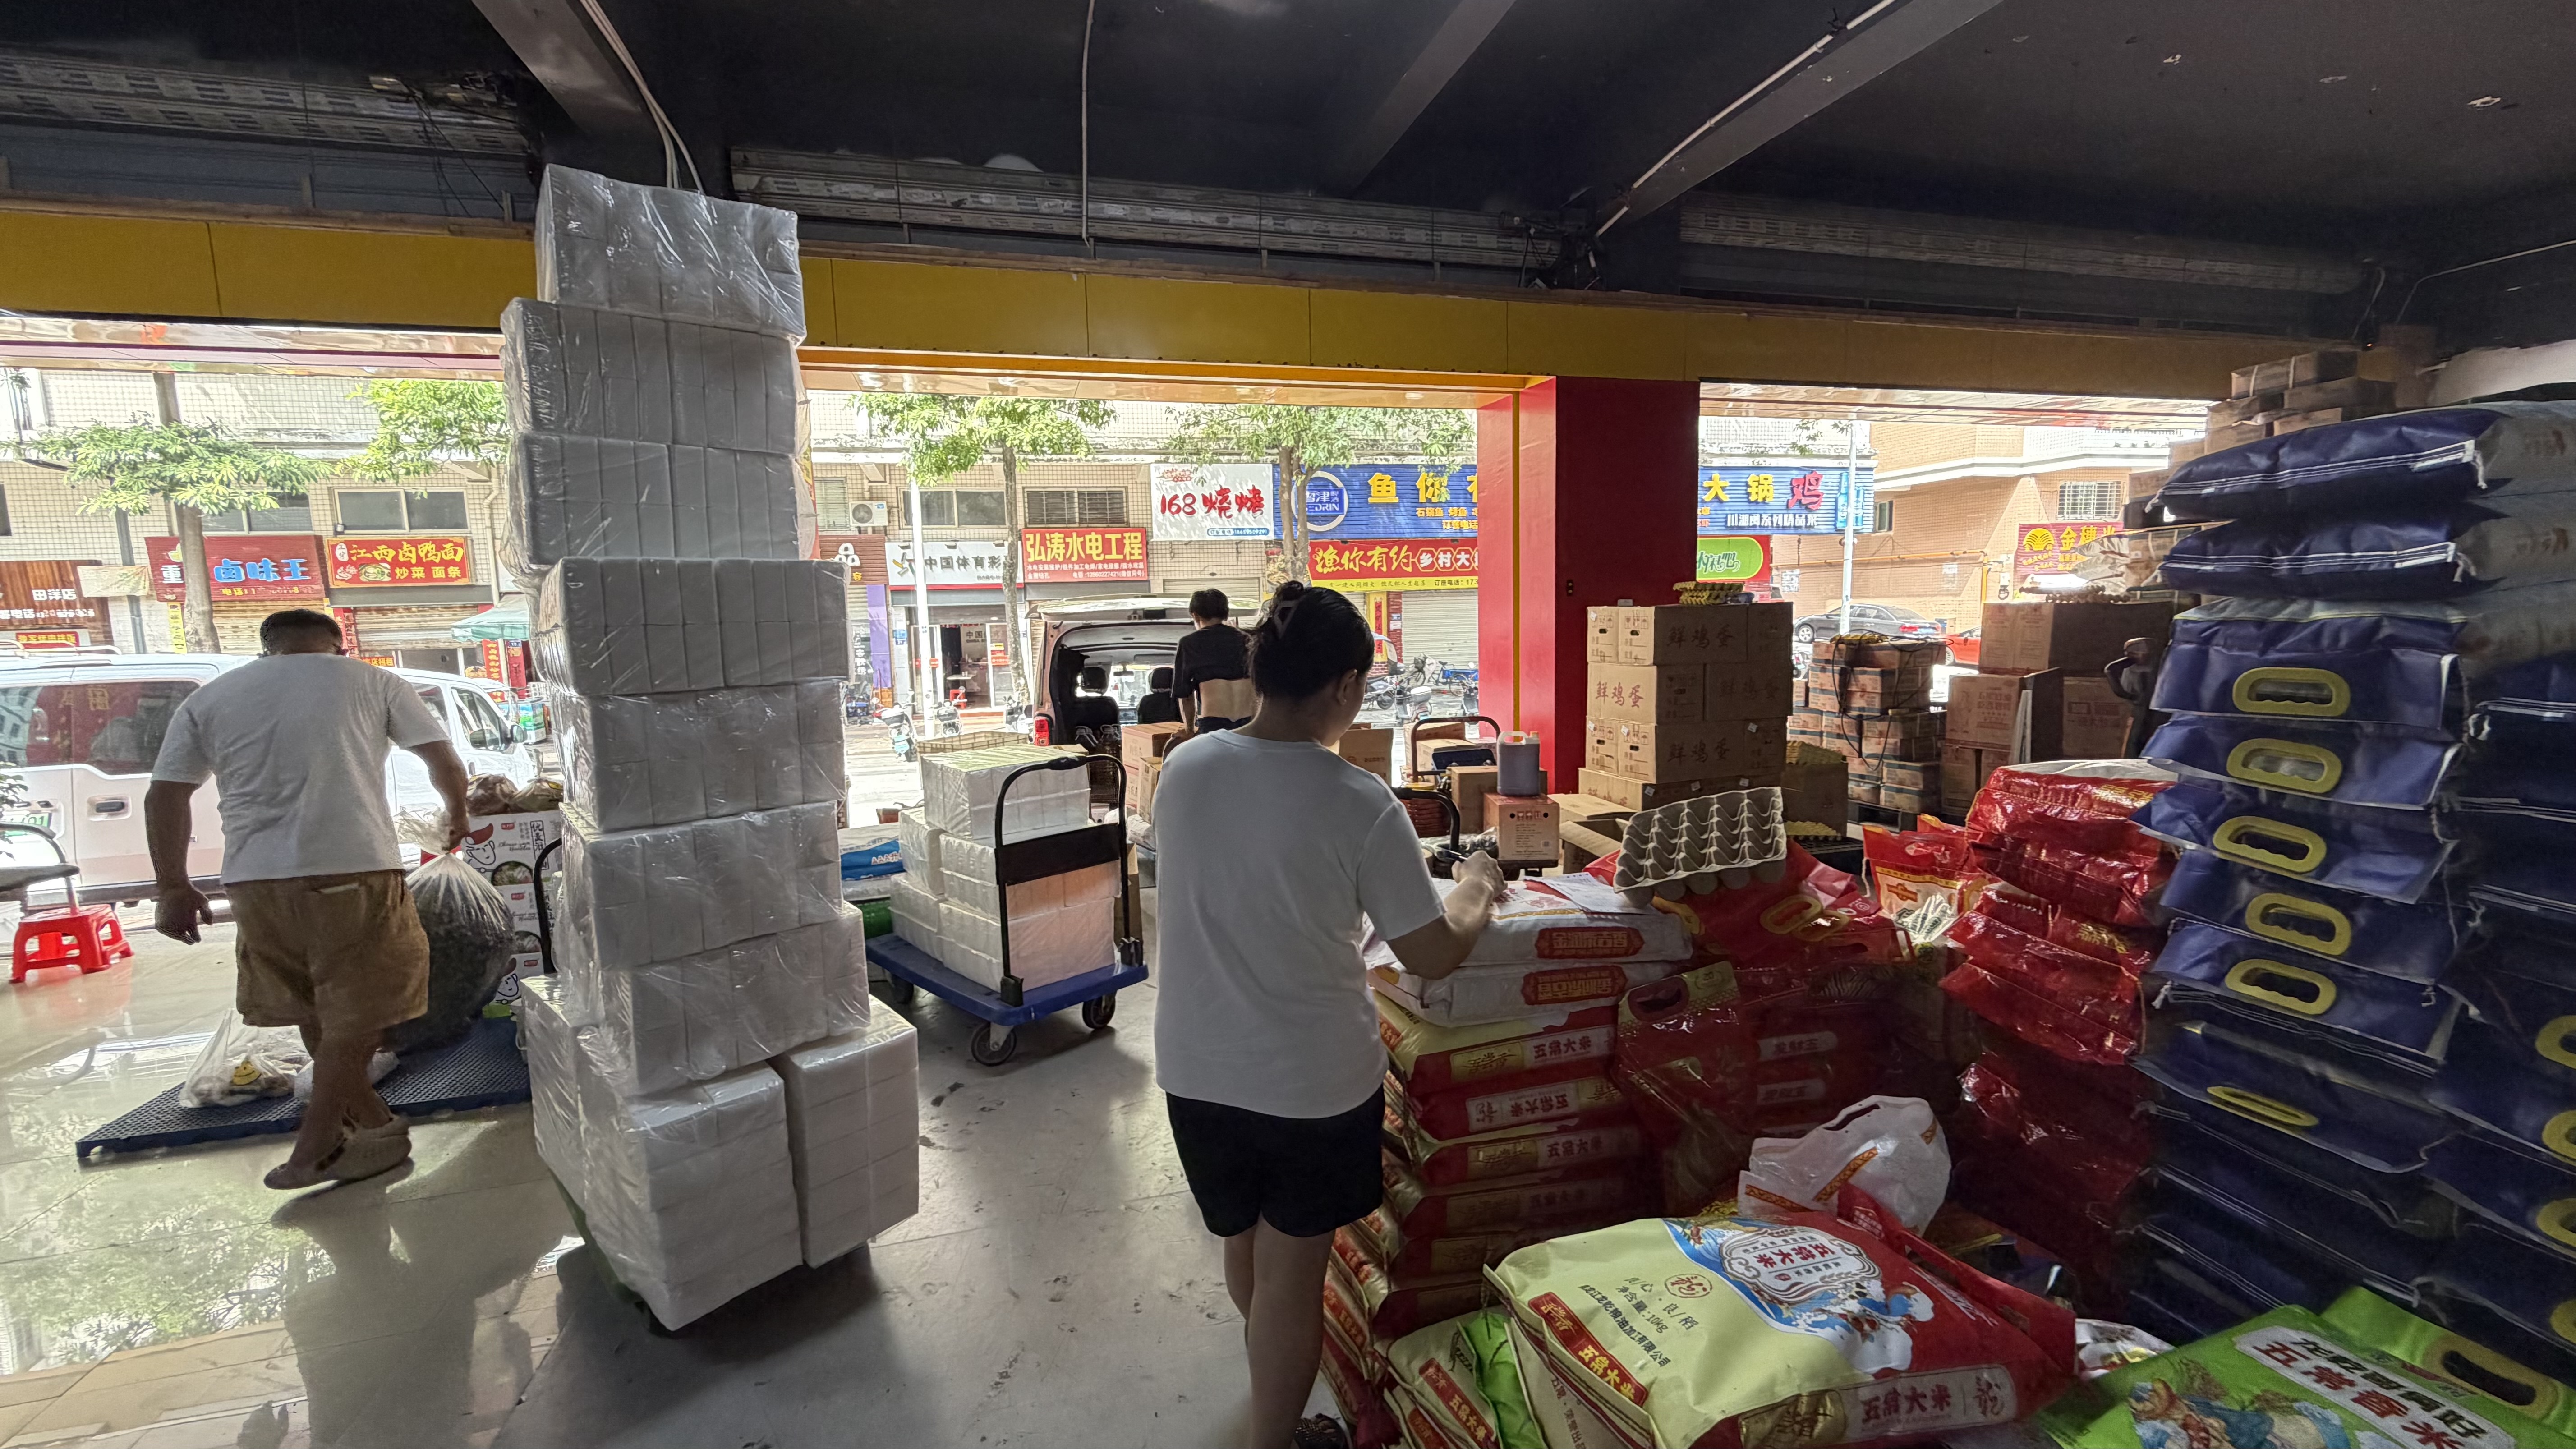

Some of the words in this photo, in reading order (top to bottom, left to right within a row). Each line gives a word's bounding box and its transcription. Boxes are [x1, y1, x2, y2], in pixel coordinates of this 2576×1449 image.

[1160, 493, 1196, 515] 168
[1201, 484, 1265, 519] 烧烤
[1702, 470, 1824, 510] 大锅鸡
[349, 541, 464, 564] 江西卤鸭面
[1025, 532, 1143, 562] 弘涛水电工程
[1314, 544, 1412, 574] 渔你有约
[161, 565, 184, 583] 重
[214, 558, 312, 582] 卤味王
[395, 567, 426, 579] 炒菜
[431, 566, 462, 578] 面条
[924, 555, 1008, 571] 中国体育彩
[1667, 624, 1736, 650] 鲜鸡蛋
[1595, 681, 1644, 708] 鲜鸡蛋
[1667, 736, 1730, 764] 鲜鸡蛋
[1534, 1035, 1592, 1059] 五常大米
[1510, 1094, 1569, 1118] 五常大米
[1752, 1242, 1836, 1269] 五常大米
[1578, 1345, 1636, 1399] 五常大米
[1861, 1384, 1952, 1423] 五常大米
[2252, 1341, 2466, 1449] 五常香米
[1449, 1394, 1488, 1442] 五常大米
